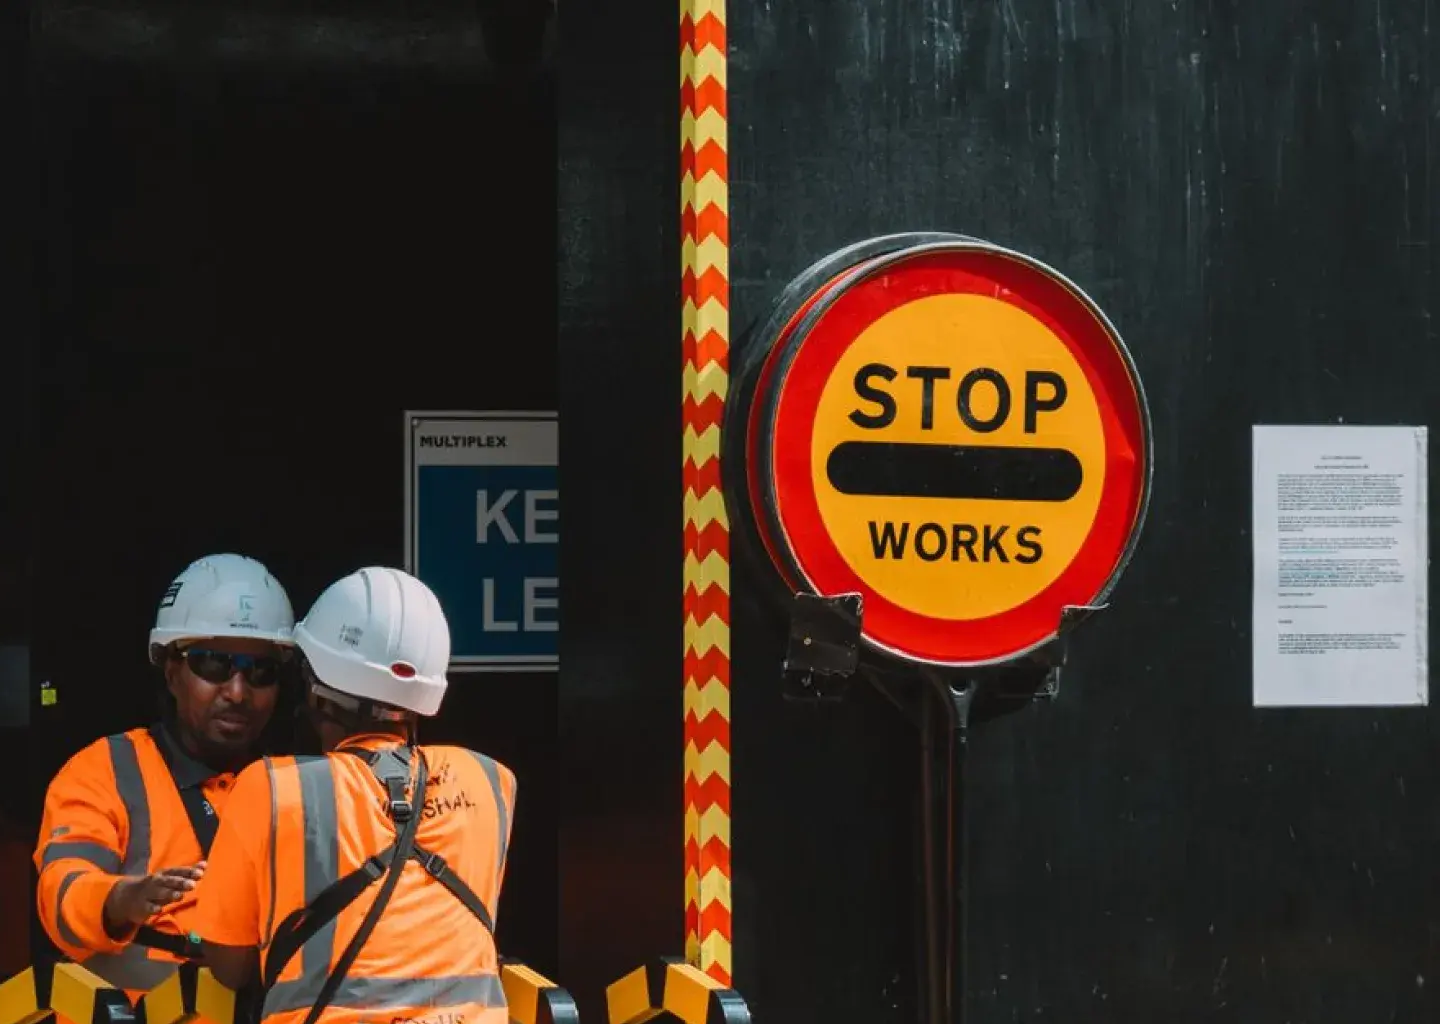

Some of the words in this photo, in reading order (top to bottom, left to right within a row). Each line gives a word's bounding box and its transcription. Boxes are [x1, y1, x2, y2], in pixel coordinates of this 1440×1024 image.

[847, 362, 1068, 434] STOP
[419, 435, 508, 448] MULTIPLEX
[867, 520, 1044, 565] WORKS
